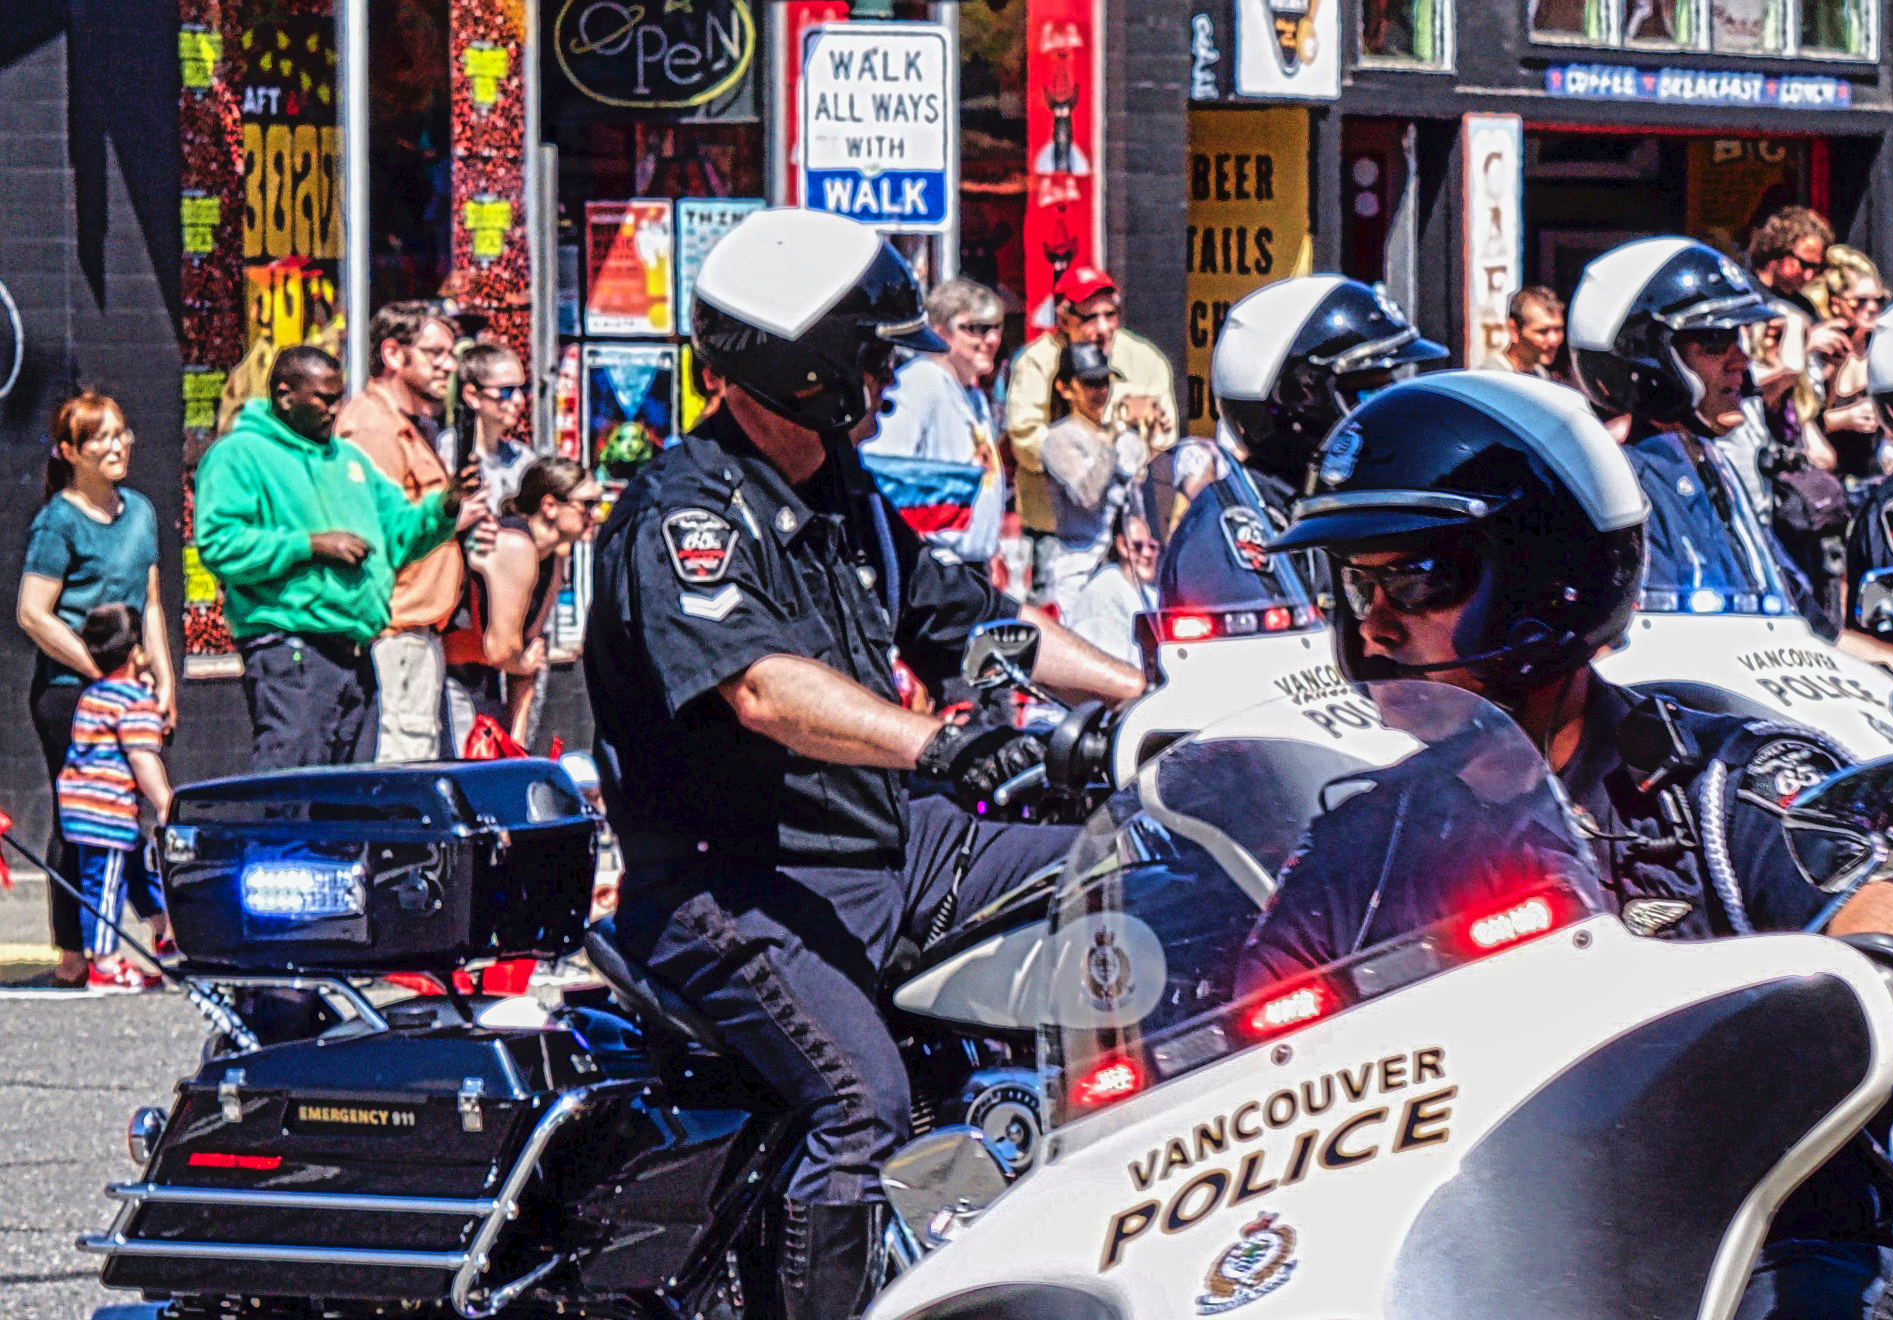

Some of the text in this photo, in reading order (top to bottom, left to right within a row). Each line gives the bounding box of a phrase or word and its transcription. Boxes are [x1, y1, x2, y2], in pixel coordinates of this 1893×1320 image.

[829, 49, 923, 82] WALK
[814, 92, 940, 124] ALL WAYS
[845, 136, 905, 159] WITH
[1192, 153, 1274, 202] BEER
[822, 176, 929, 216] WALK
[1737, 648, 1842, 673] VANCOUVER
[298, 1105, 416, 1127] EMERGENCY 911
[1127, 1046, 1446, 1192] VANCOUVER
[1098, 1085, 1459, 1274] POLICE
